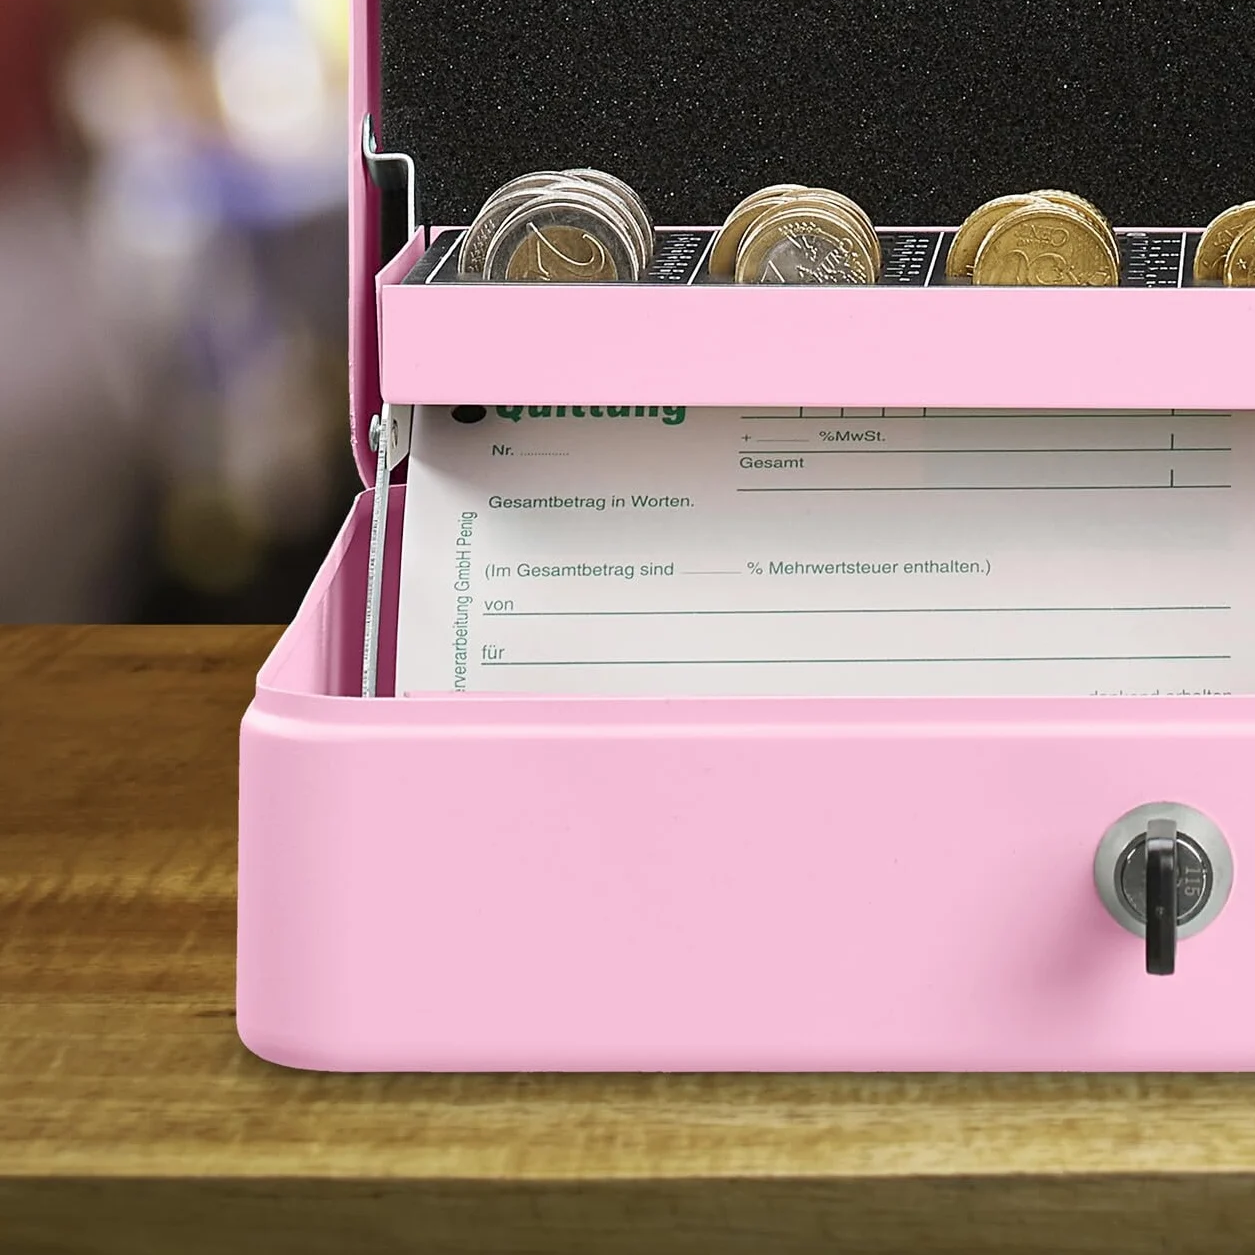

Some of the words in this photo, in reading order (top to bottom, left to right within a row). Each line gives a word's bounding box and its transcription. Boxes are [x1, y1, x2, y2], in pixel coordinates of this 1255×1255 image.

[491, 444, 514, 456] Nr.
[739, 457, 804, 469] Gesamt
[488, 495, 606, 510] Gesamtbetrag
[611, 495, 625, 507] in
[631, 495, 695, 507] Worten.
[456, 511, 478, 546] Penig
[454, 551, 471, 591] GmbH
[484, 562, 512, 579] (Im
[516, 562, 635, 579] Gesamtbetrag
[639, 562, 674, 576] sind
[747, 561, 763, 575] %
[769, 560, 898, 575] Mehrwertsteuer
[903, 559, 991, 576] enthalten.)
[484, 599, 514, 612] von
[452, 596, 473, 692] rverarbeitung
[481, 645, 505, 660] für
